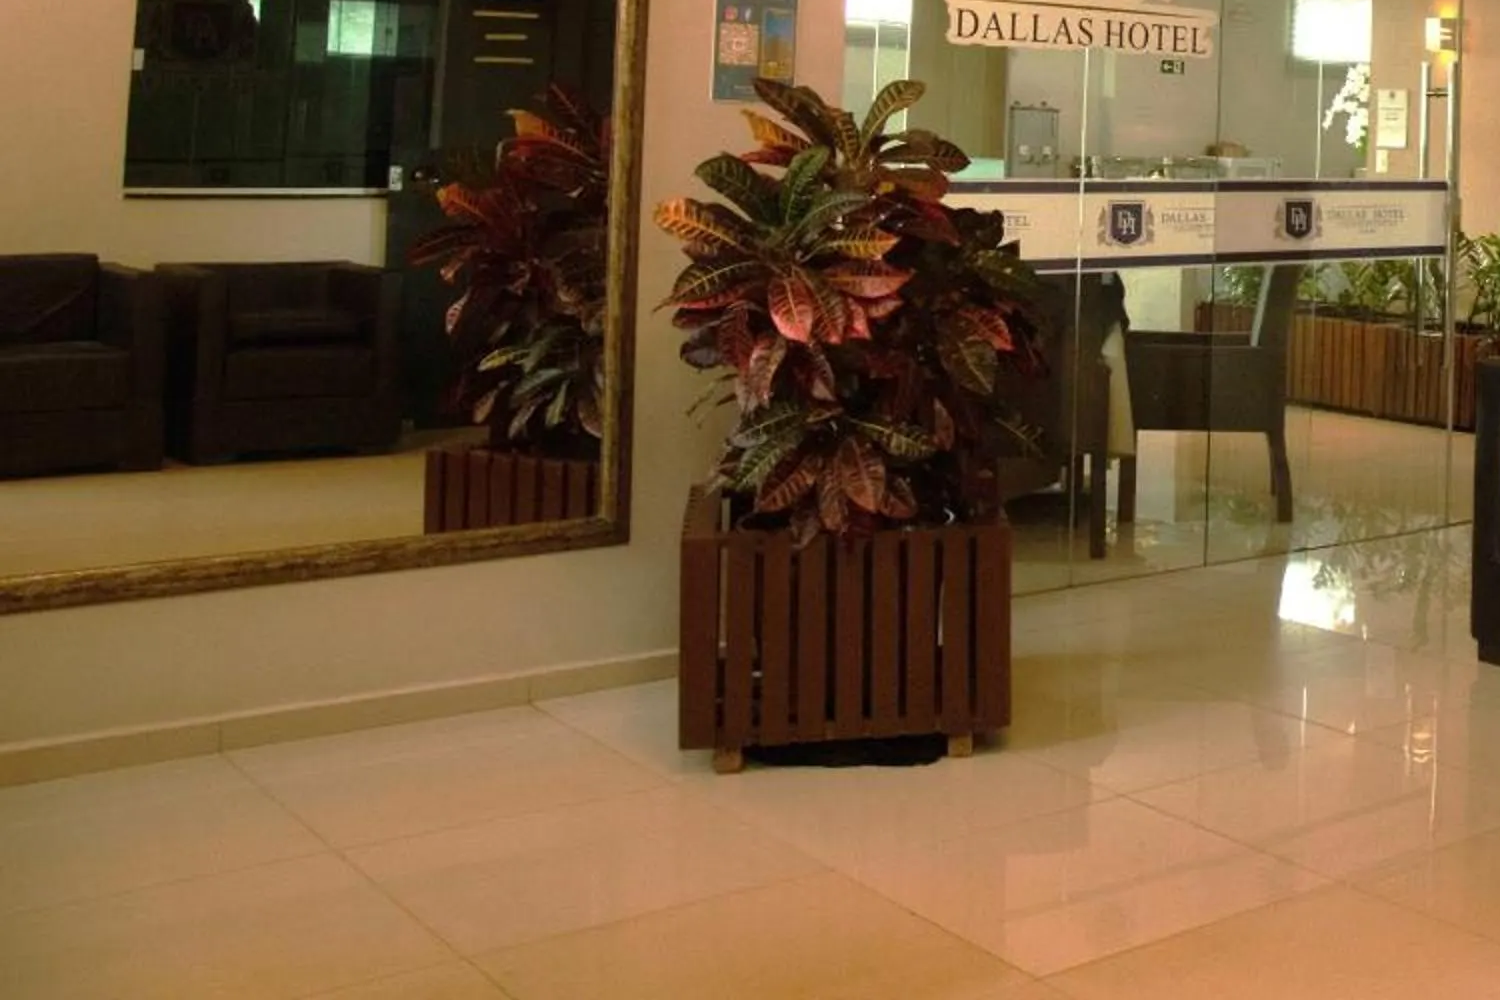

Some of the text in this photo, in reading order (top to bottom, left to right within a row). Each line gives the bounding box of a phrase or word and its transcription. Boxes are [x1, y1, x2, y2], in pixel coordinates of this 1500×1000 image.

[956, 7, 1209, 56] DALLAS HOTEL
[1160, 212, 1206, 225] DALLAS
